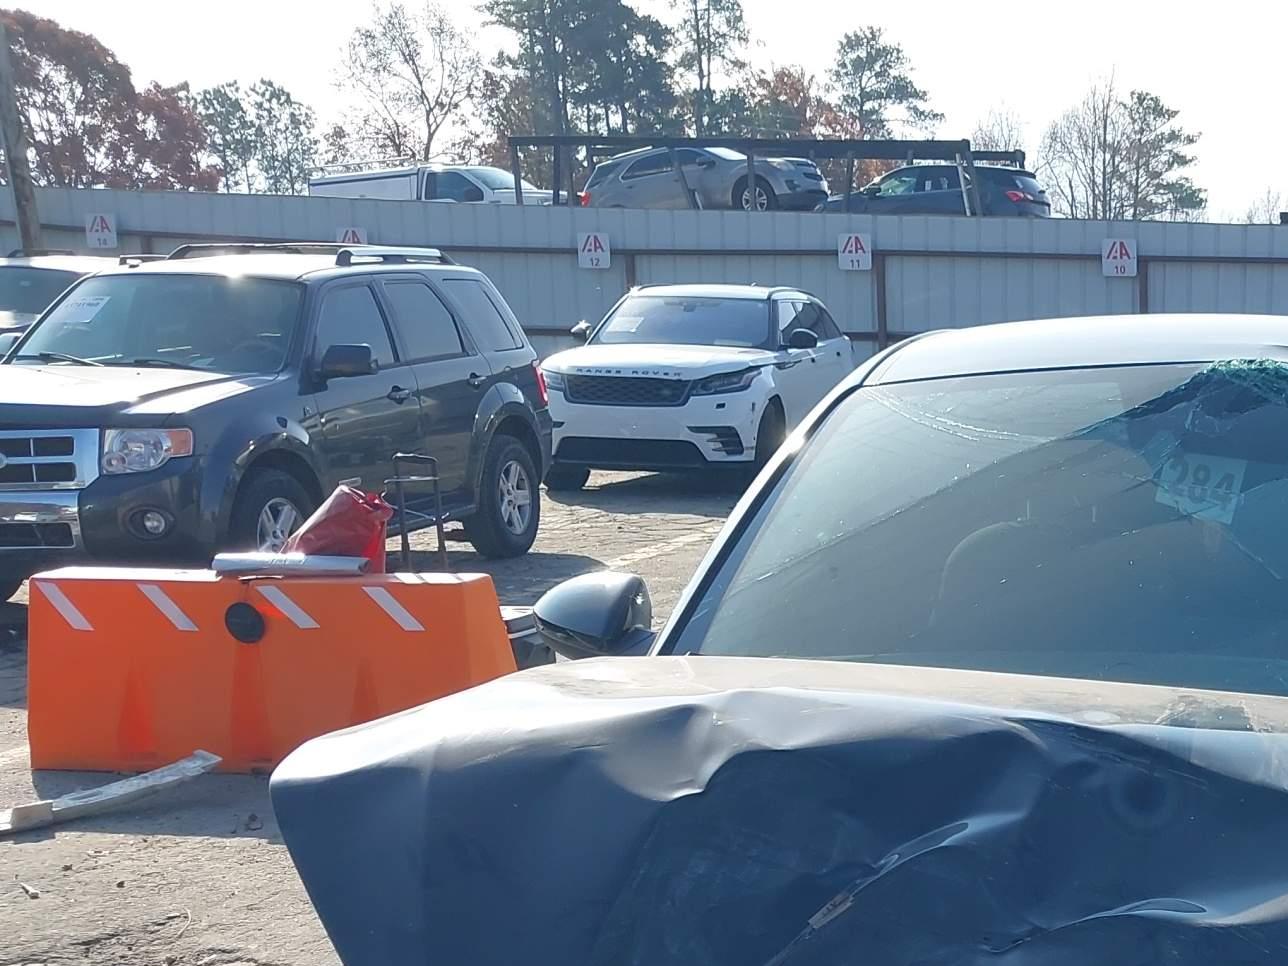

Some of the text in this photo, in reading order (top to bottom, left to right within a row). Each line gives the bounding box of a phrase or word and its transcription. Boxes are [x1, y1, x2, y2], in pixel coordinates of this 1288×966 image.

[589, 258, 600, 268] 12
[848, 260, 859, 269] 11
[1114, 265, 1125, 274] 10
